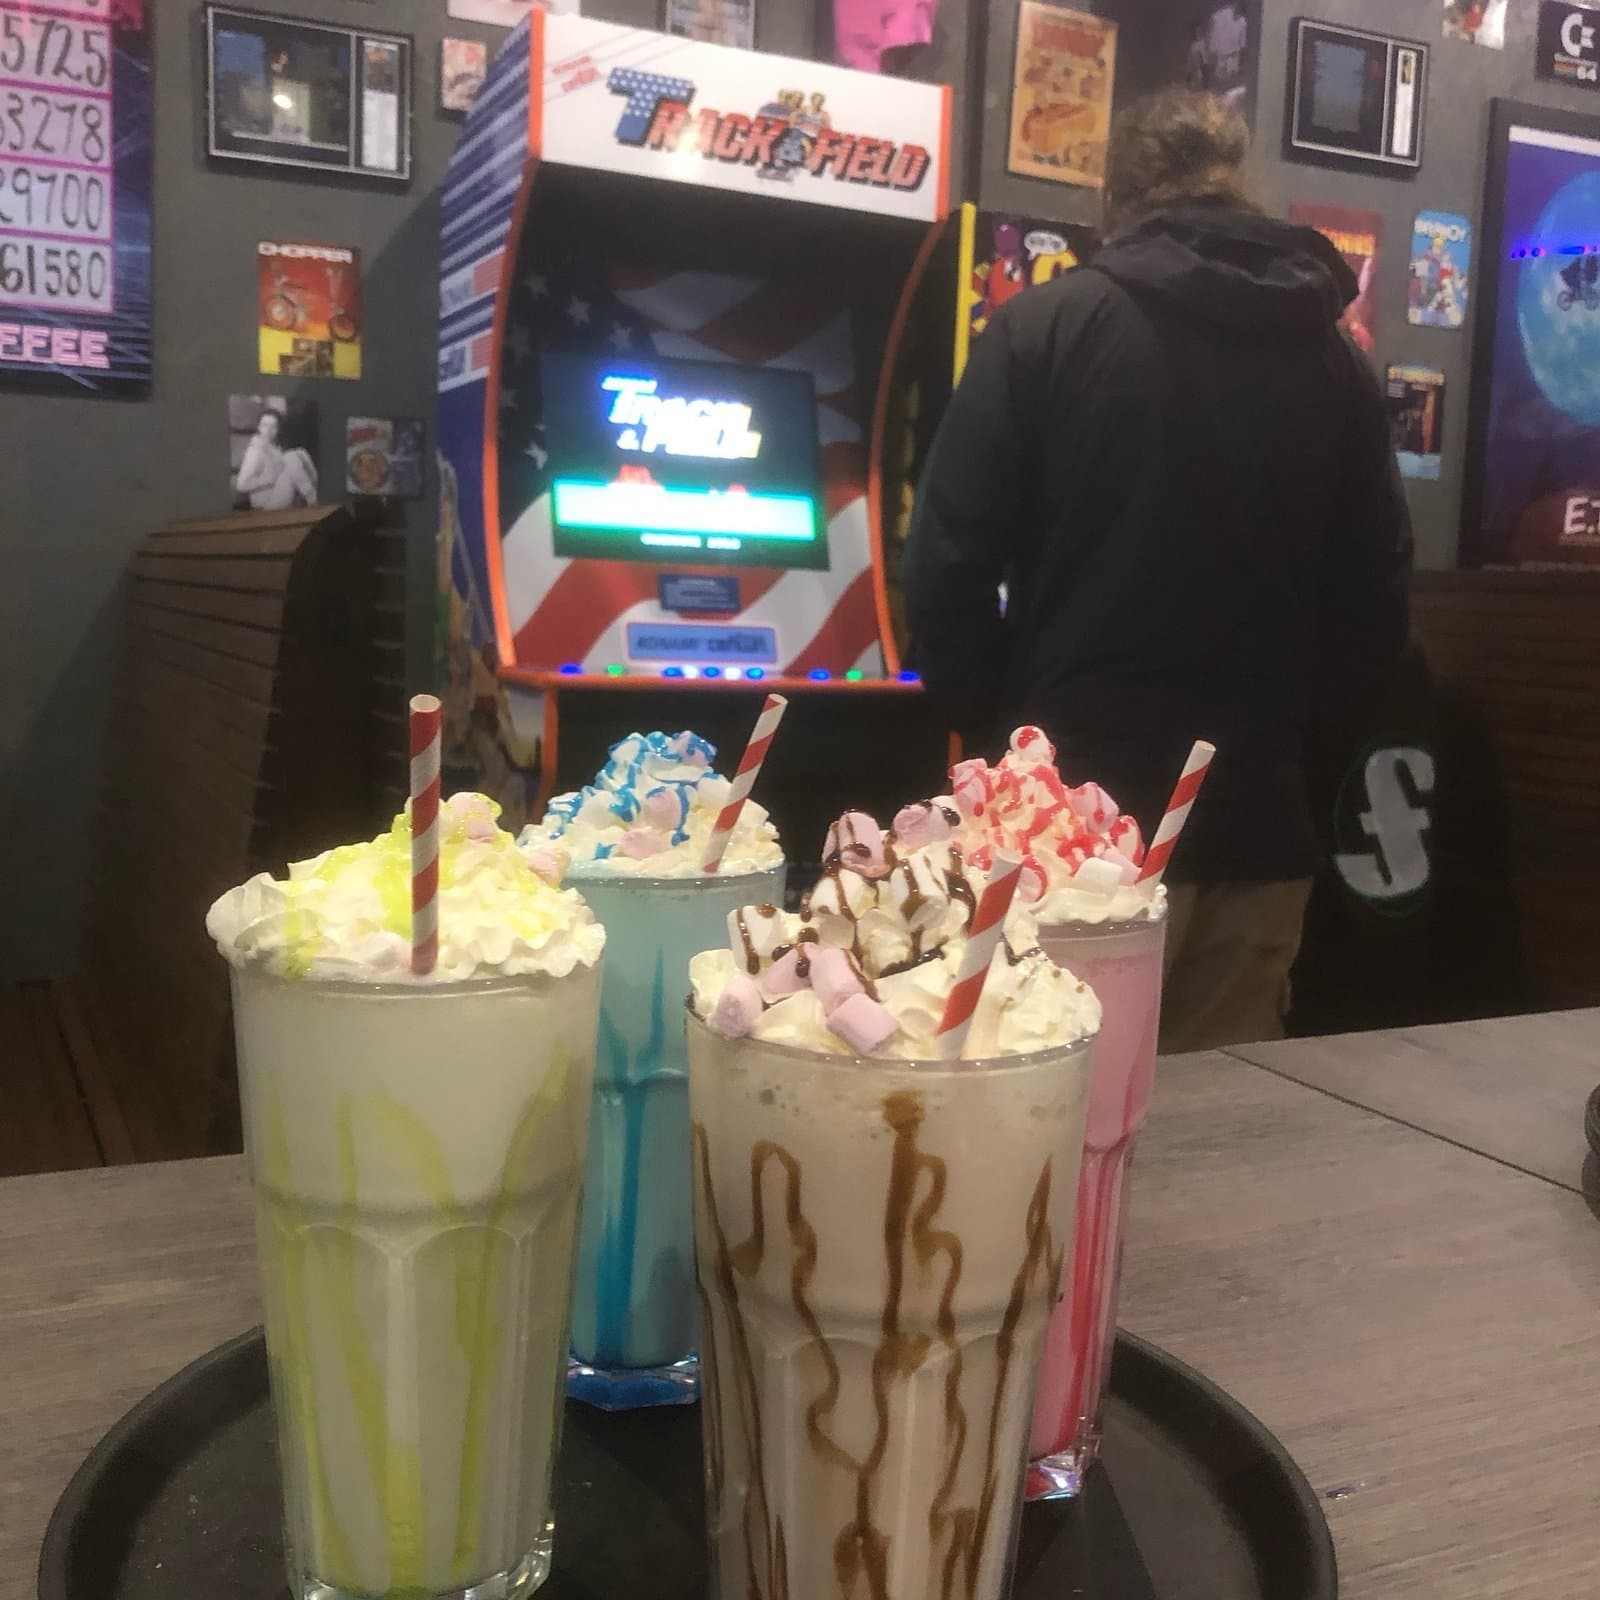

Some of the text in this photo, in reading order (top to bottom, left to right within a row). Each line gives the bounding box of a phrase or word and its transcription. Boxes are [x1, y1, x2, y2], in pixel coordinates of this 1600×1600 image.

[1, 14, 108, 88] 5725
[0, 92, 105, 163] 3278
[607, 67, 790, 170] TRACK
[807, 127, 932, 193] FIELD
[0, 243, 106, 300] 61580
